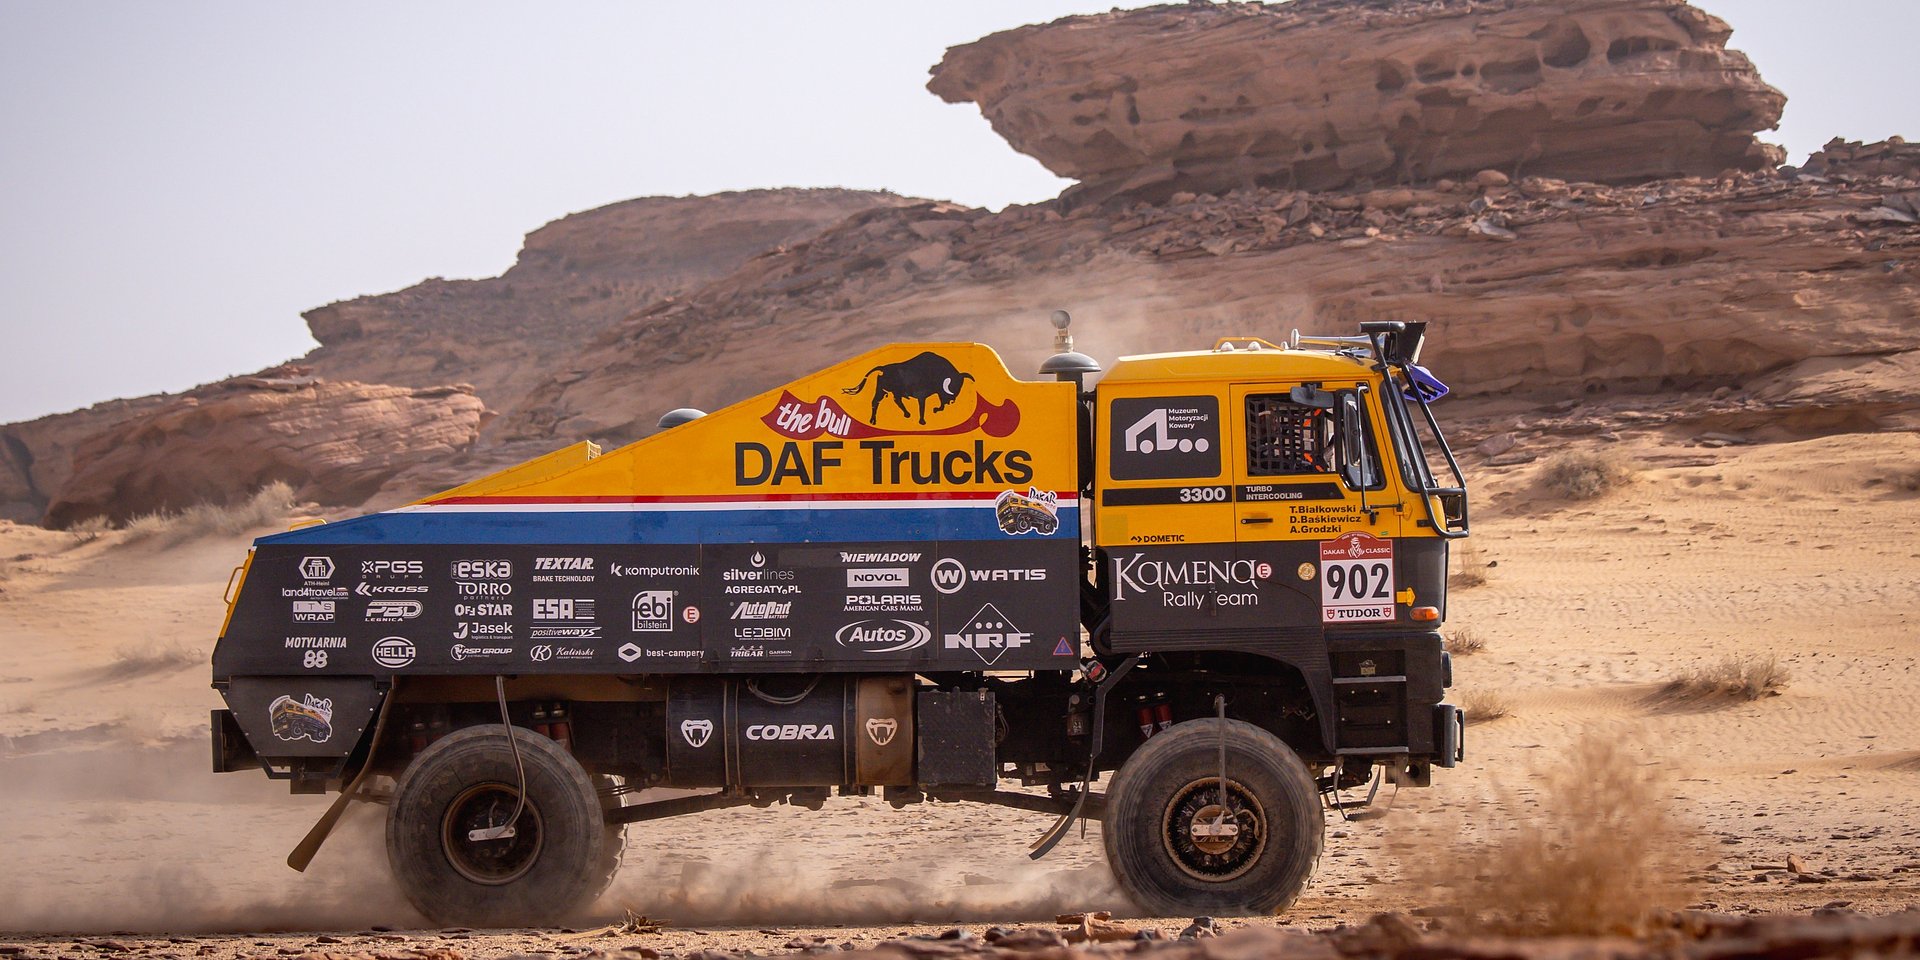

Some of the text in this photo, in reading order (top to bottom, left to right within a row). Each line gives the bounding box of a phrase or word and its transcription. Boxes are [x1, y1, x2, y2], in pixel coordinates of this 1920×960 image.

[776, 400, 851, 436] the bull
[1169, 414, 1209, 422] Motoryzacji
[735, 440, 1033, 487] DAF Trucks
[1029, 487, 1056, 505] DAKAR
[1180, 487, 1226, 503] 3300
[1246, 492, 1303, 500] INTERCOOLING
[1289, 505, 1357, 514] T.Białkowski
[1289, 514, 1362, 524] D.Baśkiewicz
[1289, 524, 1342, 534] A.Grodzki
[1144, 535, 1185, 543] DOMETIC
[375, 560, 424, 574] PGS
[457, 561, 511, 578] eska
[625, 565, 700, 578] komputronik
[854, 574, 902, 582] NOVOL
[970, 569, 1046, 582] WATIS
[1326, 563, 1390, 600] 902
[282, 587, 349, 597] land4travel.com
[455, 581, 512, 595] TORRO
[846, 595, 922, 605] POLARIS
[1163, 591, 1258, 609] Rally eam
[296, 603, 332, 611] ITS
[477, 603, 513, 616] STAR
[532, 599, 574, 619] ESA
[294, 613, 334, 621] WRAP
[1338, 609, 1381, 618] TUDOR
[471, 622, 513, 634] Jasek
[637, 620, 668, 629] bilstein
[531, 627, 596, 638] positiveways
[734, 627, 791, 638] LEDBIM
[848, 626, 907, 642] Autos
[284, 637, 347, 648] MOTYLARNIA
[944, 633, 1031, 649] NRF
[376, 646, 416, 658] HELLA
[646, 649, 705, 659] best-campery
[303, 650, 328, 668] 88
[305, 694, 330, 712] DAKAR
[745, 725, 835, 740] COBRA
